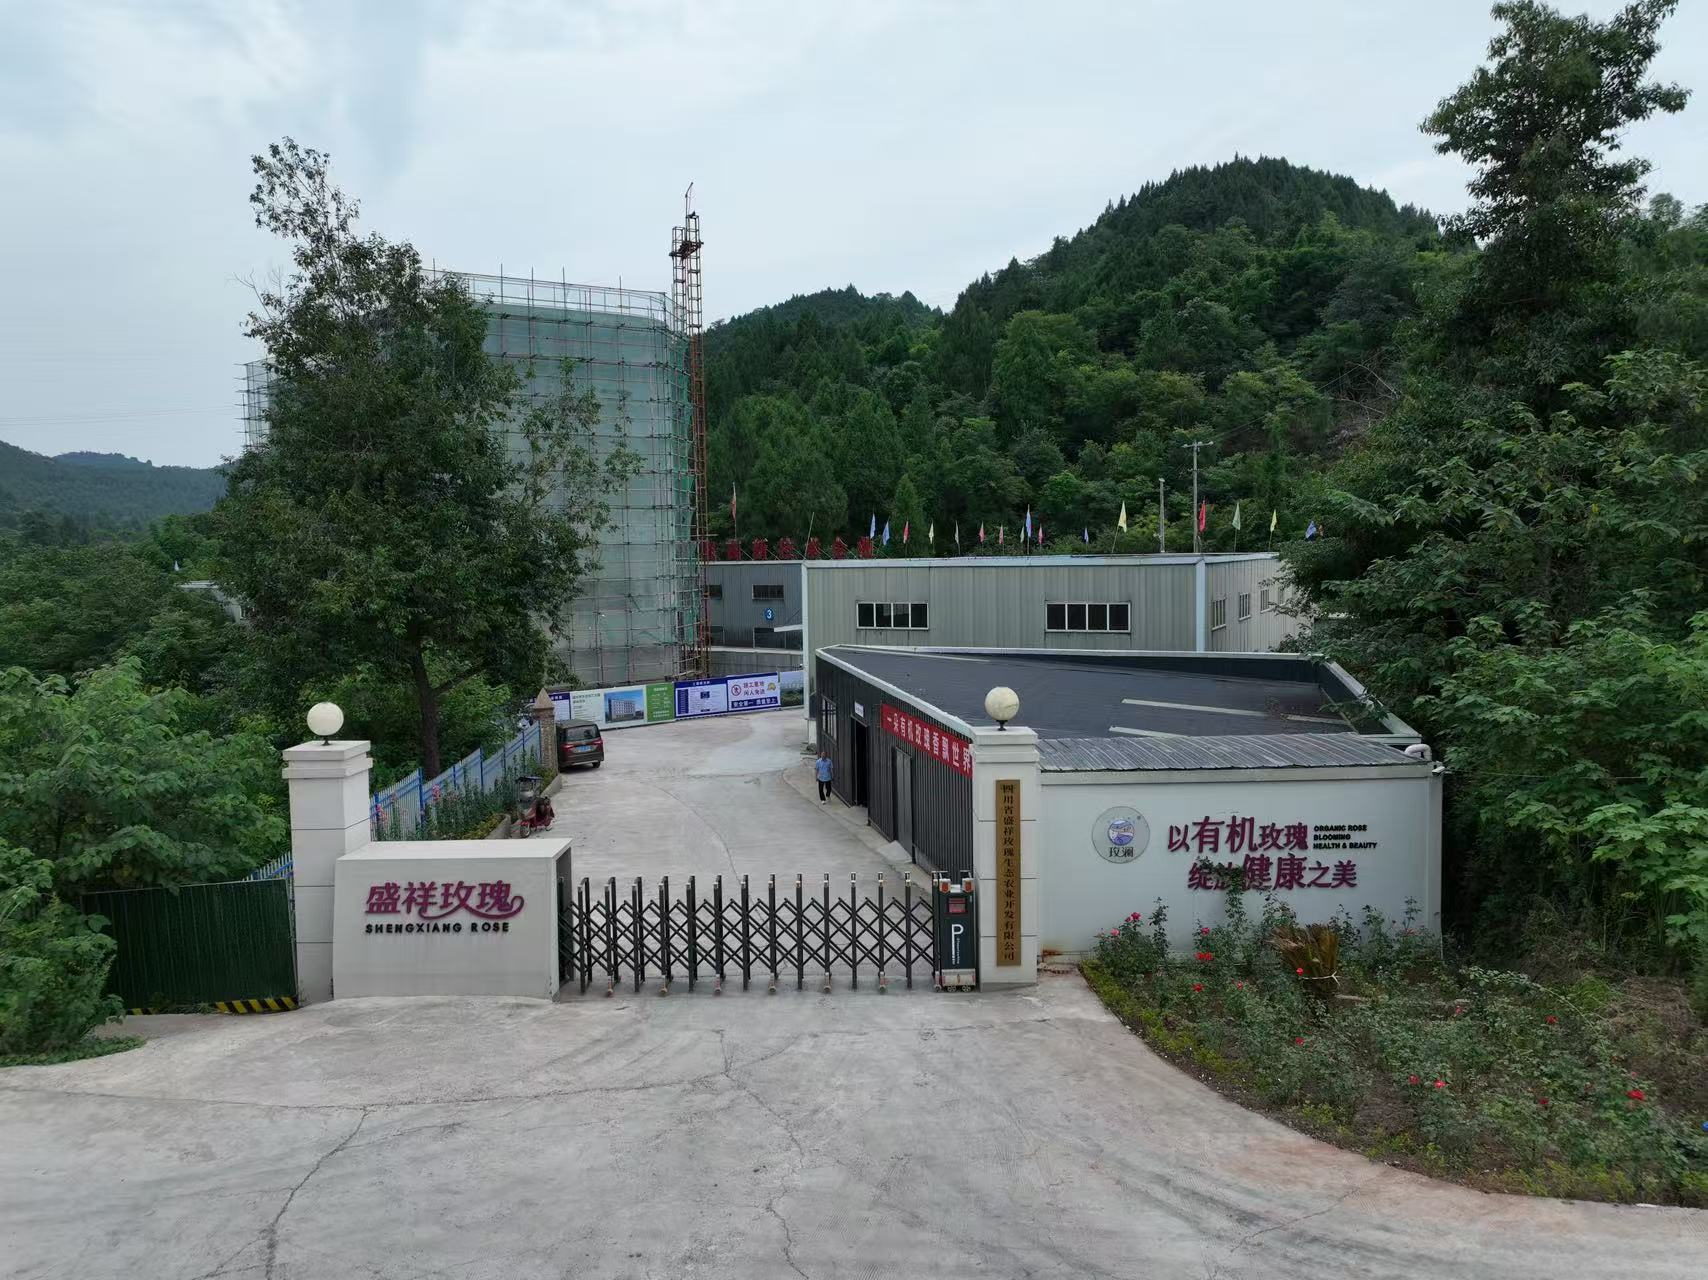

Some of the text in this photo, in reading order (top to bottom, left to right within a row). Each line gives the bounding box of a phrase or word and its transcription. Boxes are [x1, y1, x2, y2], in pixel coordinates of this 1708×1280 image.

[766, 609, 772, 619] 3
[1347, 824, 1367, 832] ROSE
[1167, 815, 1309, 853] 以有机玫瑰
[1313, 833, 1351, 841] BLOOMING
[1313, 842, 1340, 850] HEALTH
[1002, 784, 1015, 961] 四川省盛祥玫瑰生态农业开发有限公司
[364, 879, 524, 920] 盛祥玫瑰
[365, 921, 510, 934] SHENGXIANG ROSE
